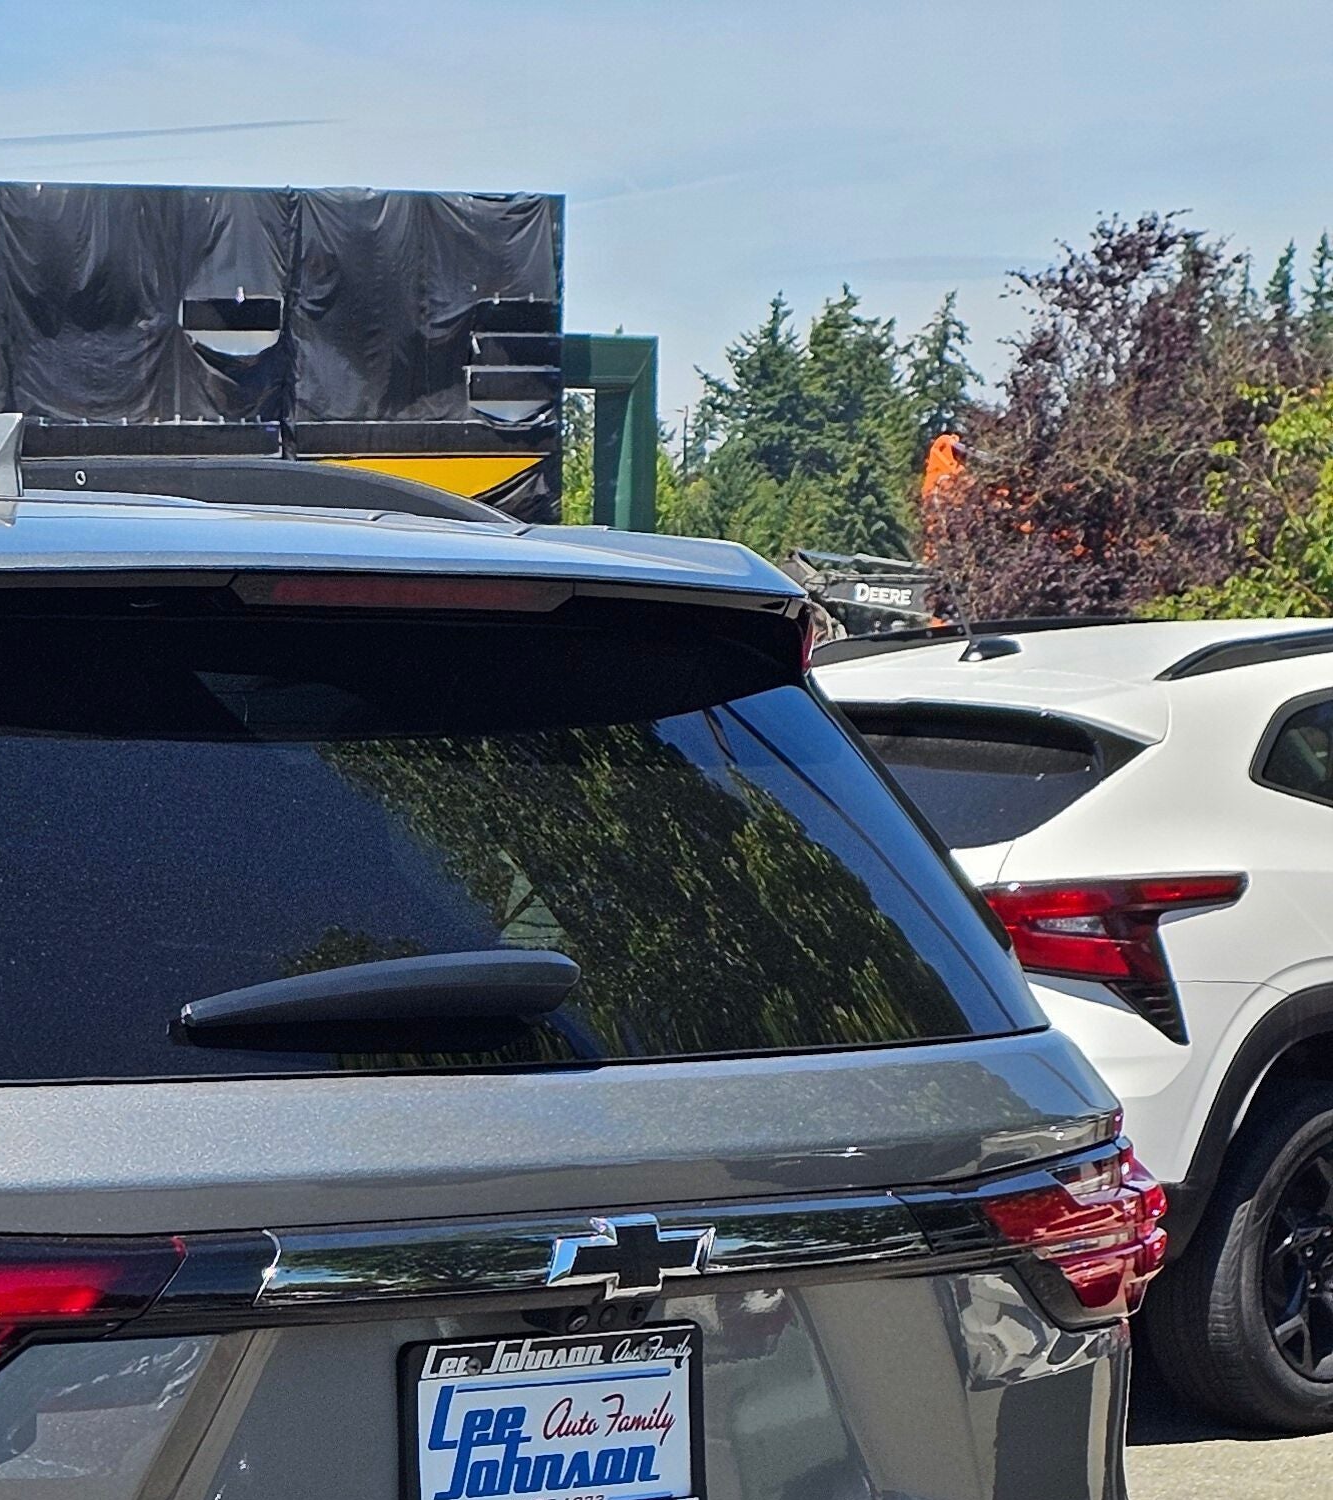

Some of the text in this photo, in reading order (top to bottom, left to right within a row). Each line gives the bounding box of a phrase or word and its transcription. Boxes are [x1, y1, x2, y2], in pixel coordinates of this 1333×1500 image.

[855, 582, 912, 606] DEERE
[482, 1338, 604, 1374] Johnson
[612, 1338, 645, 1362] Aut
[428, 1385, 676, 1450] Lee Auto Family
[434, 1432, 661, 1500] Johnson
